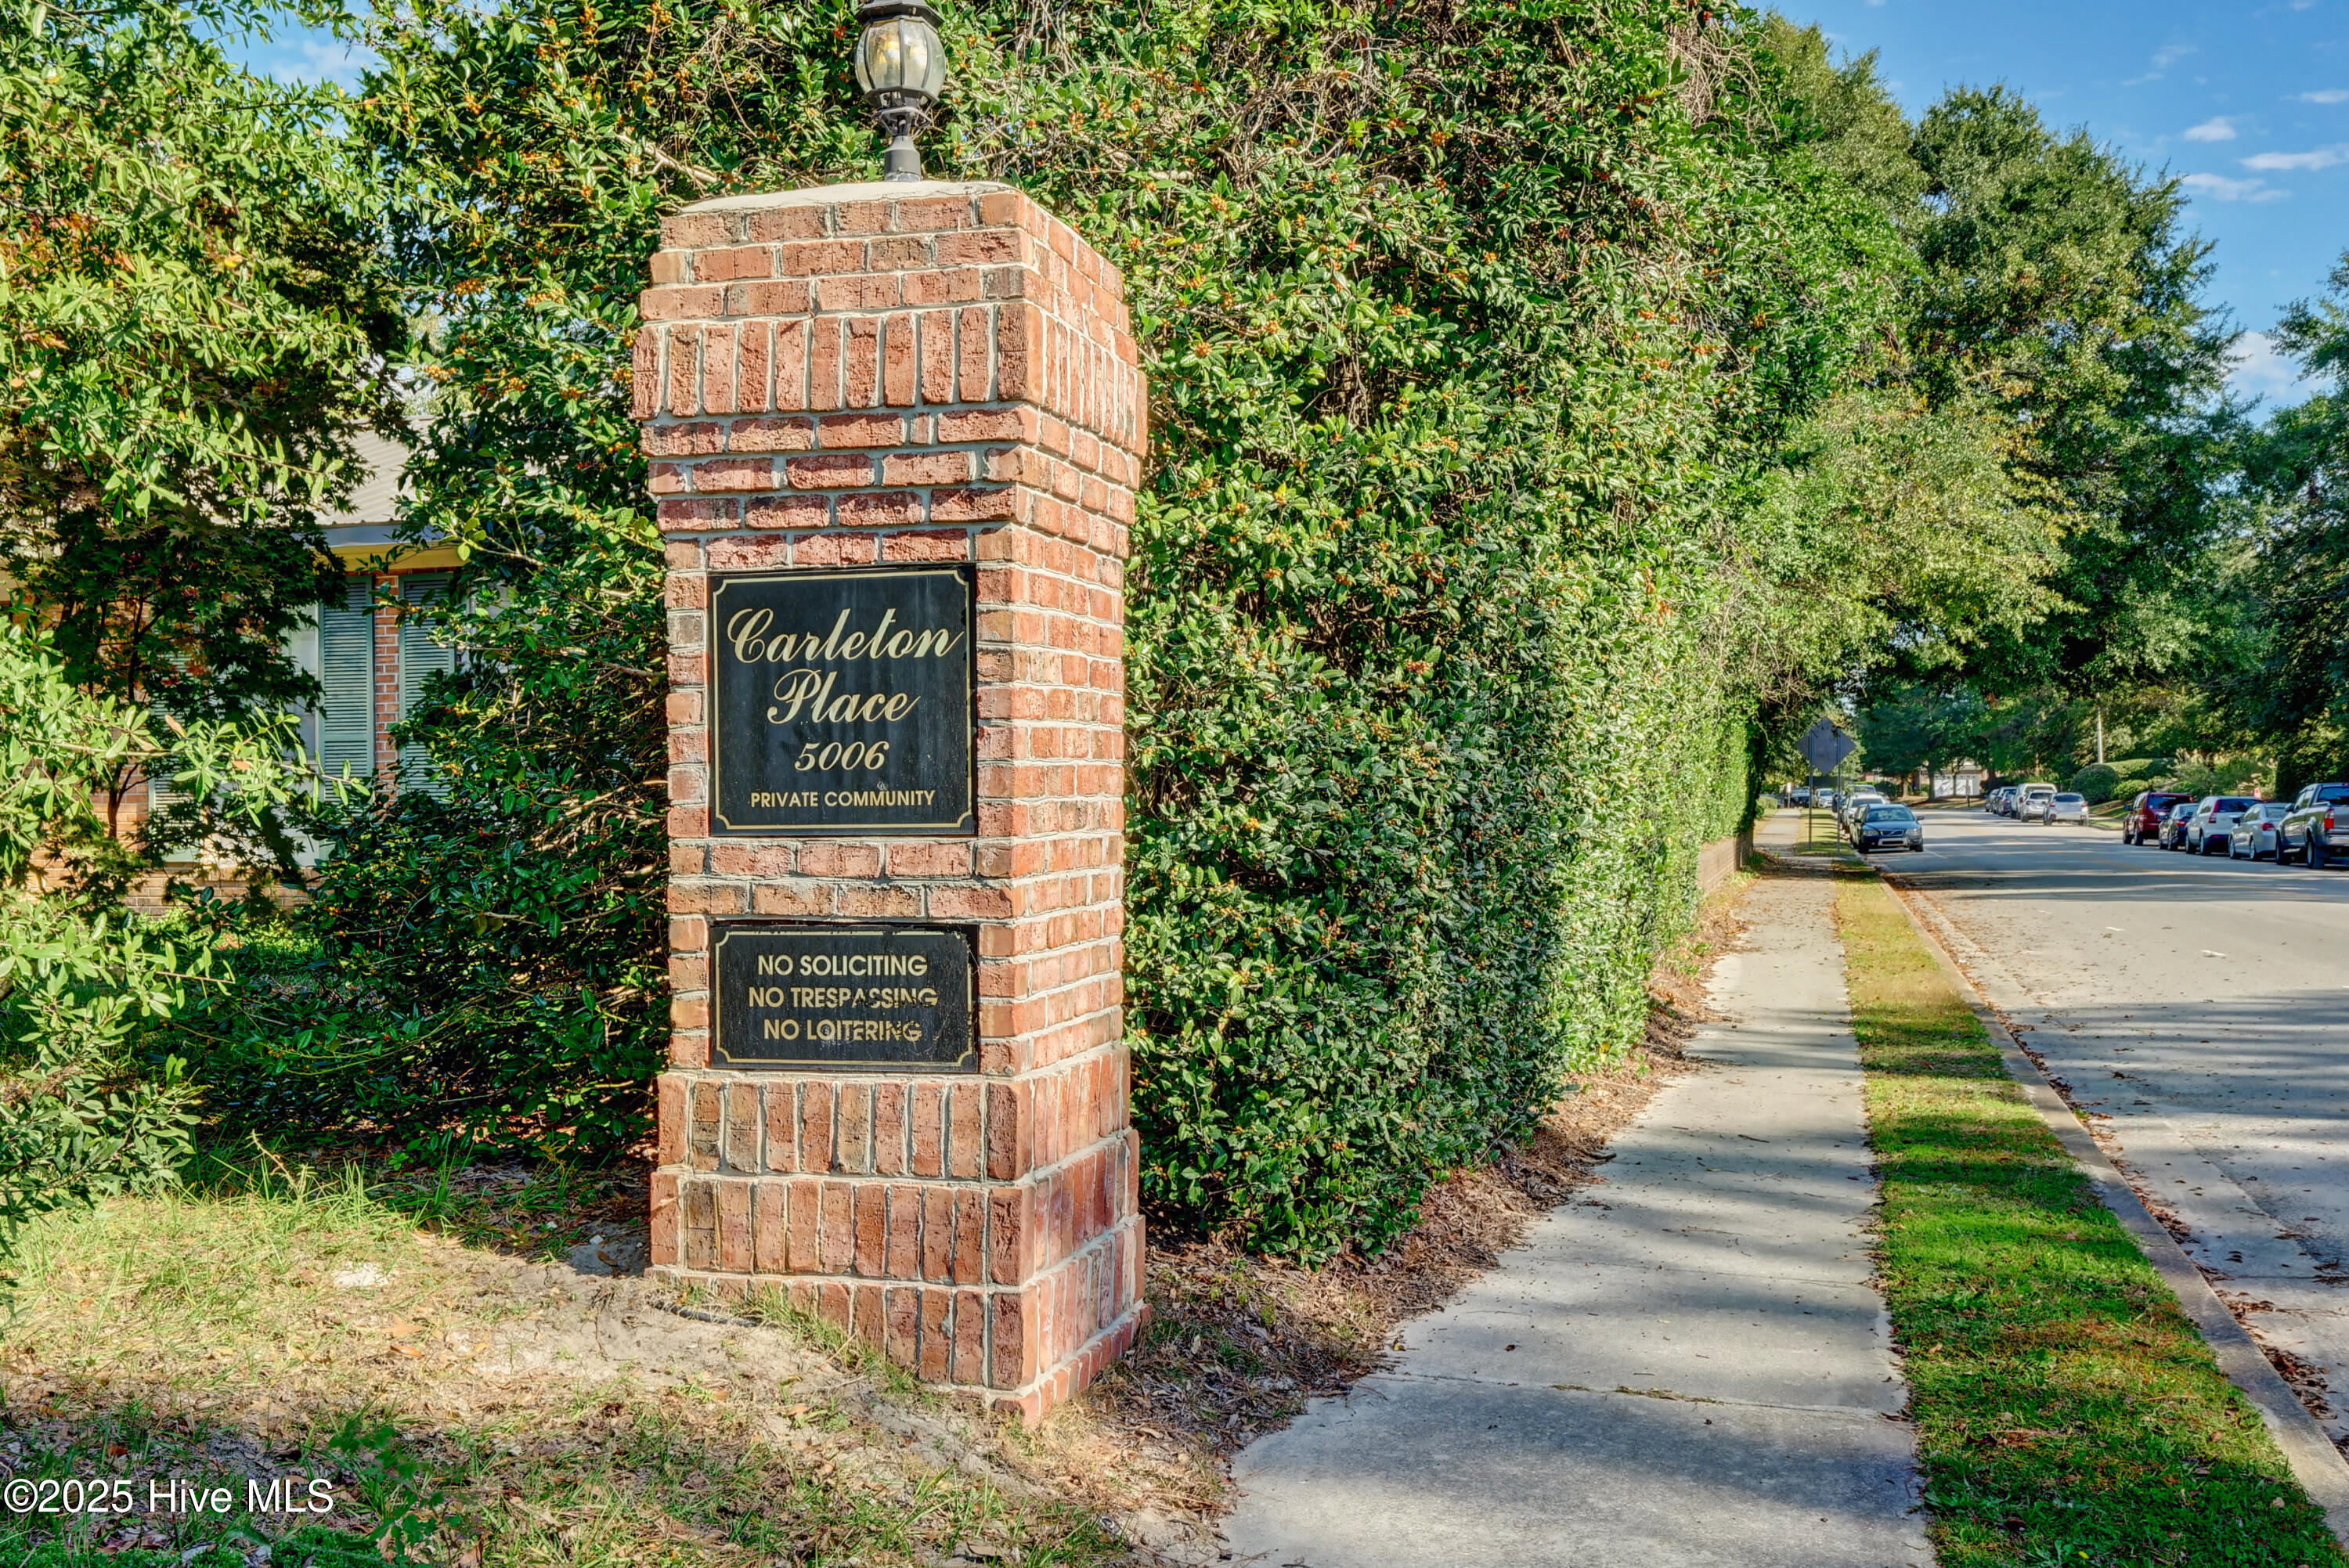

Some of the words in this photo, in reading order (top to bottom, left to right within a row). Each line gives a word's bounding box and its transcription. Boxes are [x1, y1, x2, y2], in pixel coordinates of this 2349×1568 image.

[727, 607, 965, 663] Carleton
[767, 669, 921, 724] Place
[794, 741, 890, 771] 5006
[750, 791, 818, 808] PRIVATE
[824, 790, 936, 807] COMMUNITY
[758, 955, 794, 976] NO
[799, 955, 928, 976] SOLICITING
[749, 986, 784, 1007] NO
[790, 986, 939, 1009] TRESPASSING
[763, 1019, 799, 1040] NO
[807, 1019, 922, 1041] LOITERING
